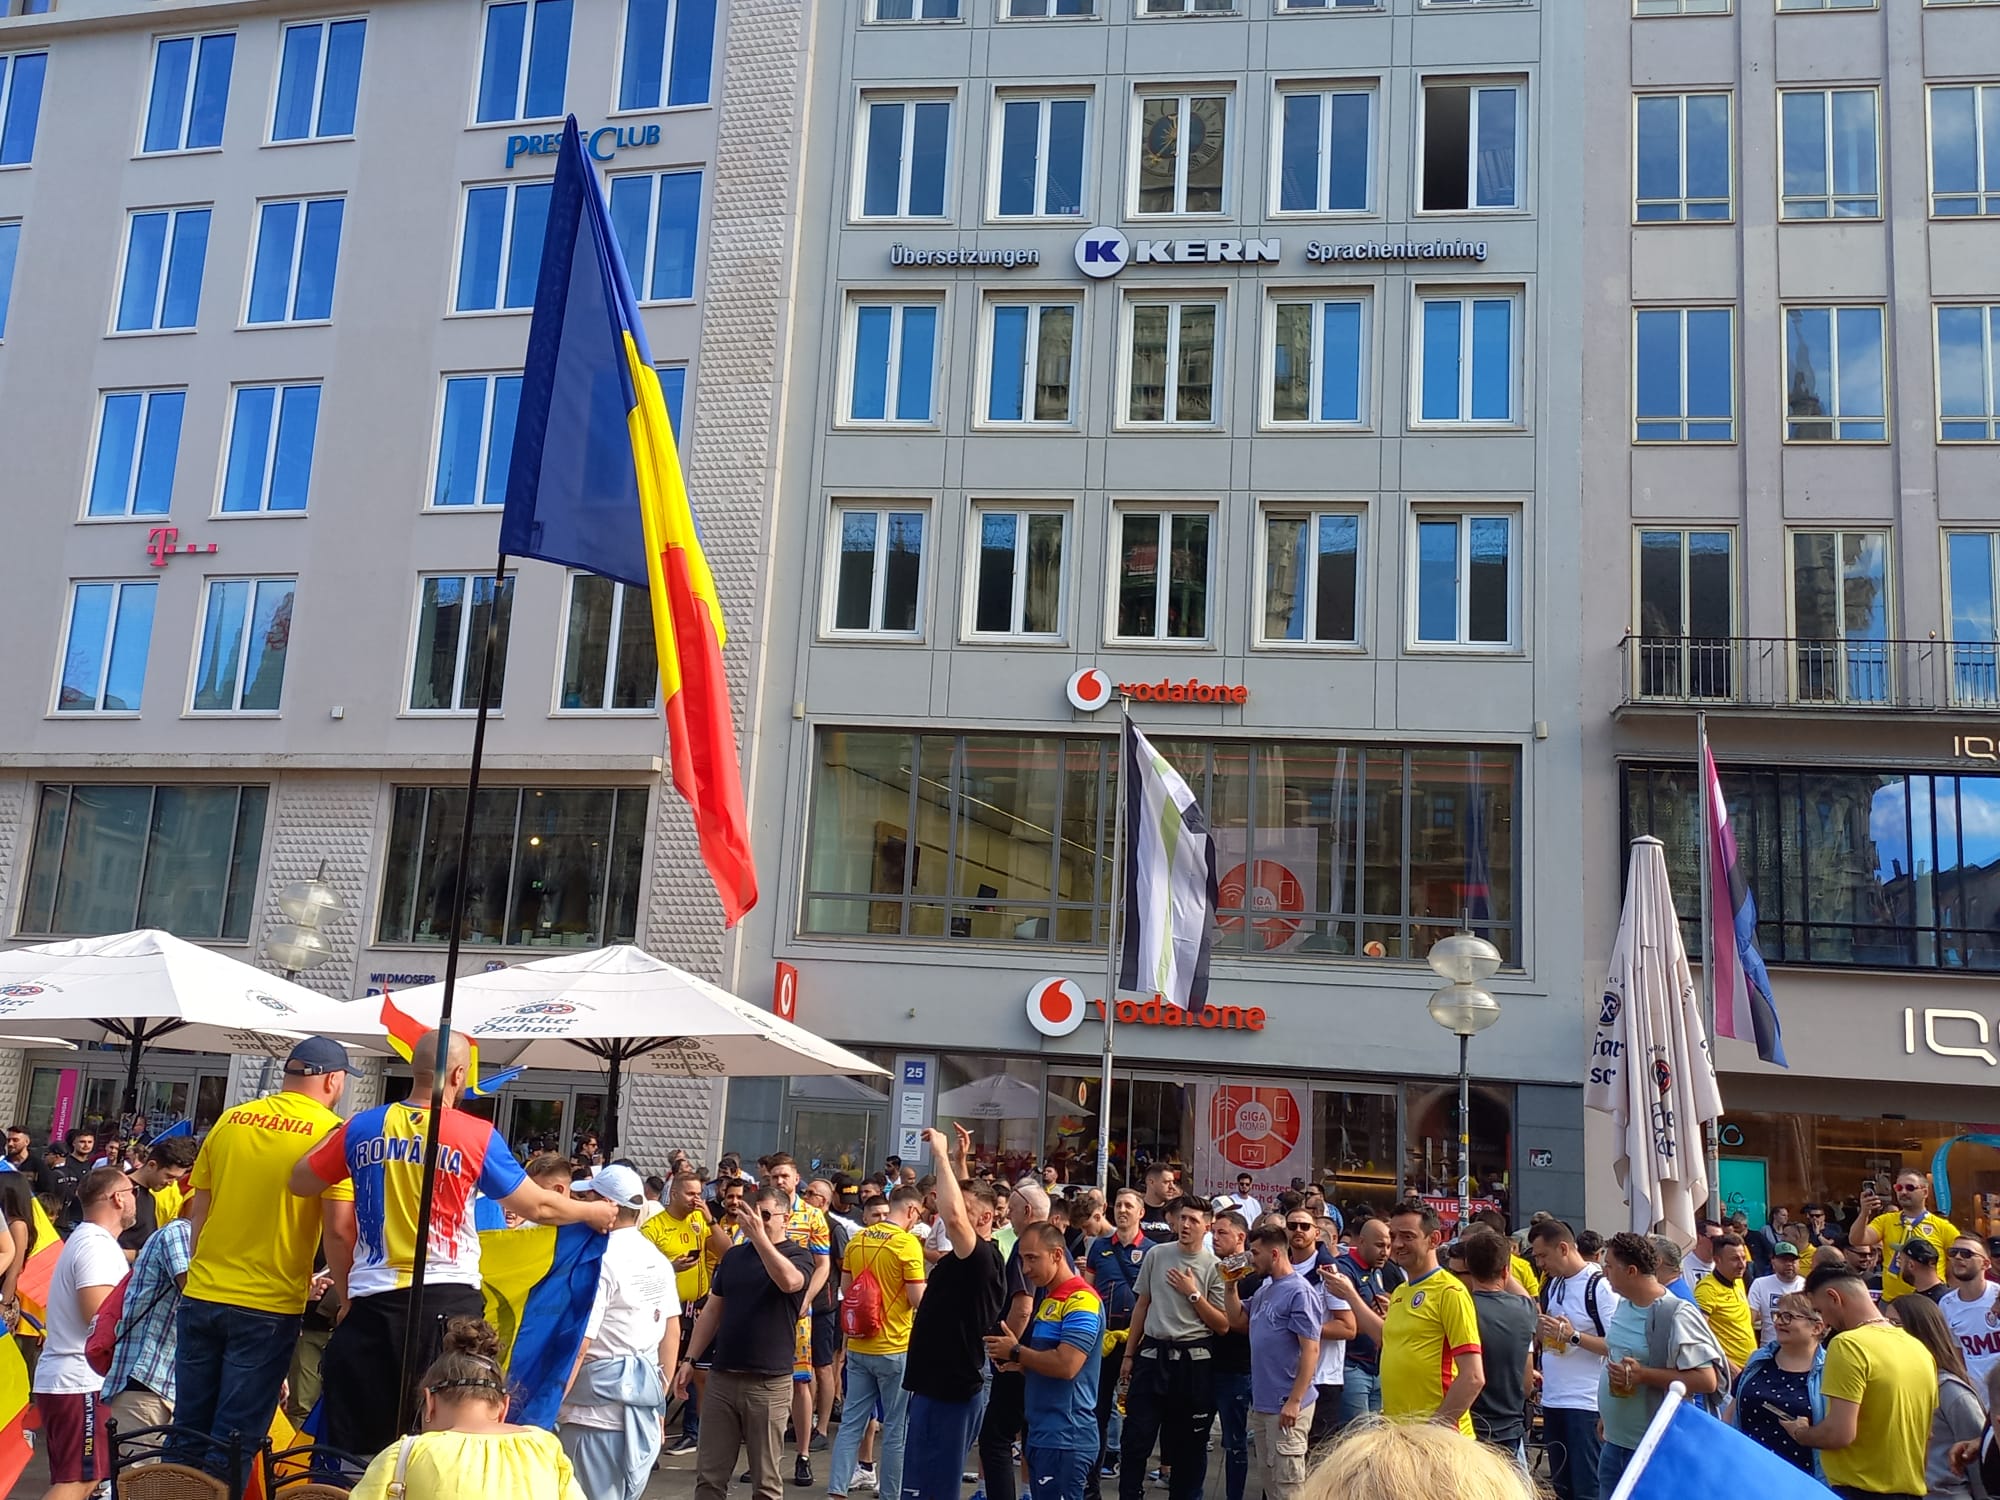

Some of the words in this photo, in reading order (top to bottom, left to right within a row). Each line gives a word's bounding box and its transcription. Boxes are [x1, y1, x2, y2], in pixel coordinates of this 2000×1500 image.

[890, 242, 1040, 269] Übersetzungen
[1084, 240, 1121, 263] K
[1135, 238, 1281, 263] KERN
[1306, 239, 1487, 263] Sprachentraining
[370, 973, 435, 985] WILDMOSERS
[906, 1067, 923, 1078] 25
[228, 1111, 314, 1136] ROMÂNIA
[1240, 1111, 1266, 1121] GIGA
[356, 1134, 462, 1177] ROMÂIA
[680, 1232, 689, 1244] 10
[85, 1412, 94, 1437] RALPH
[84, 1438, 93, 1456] POLO
